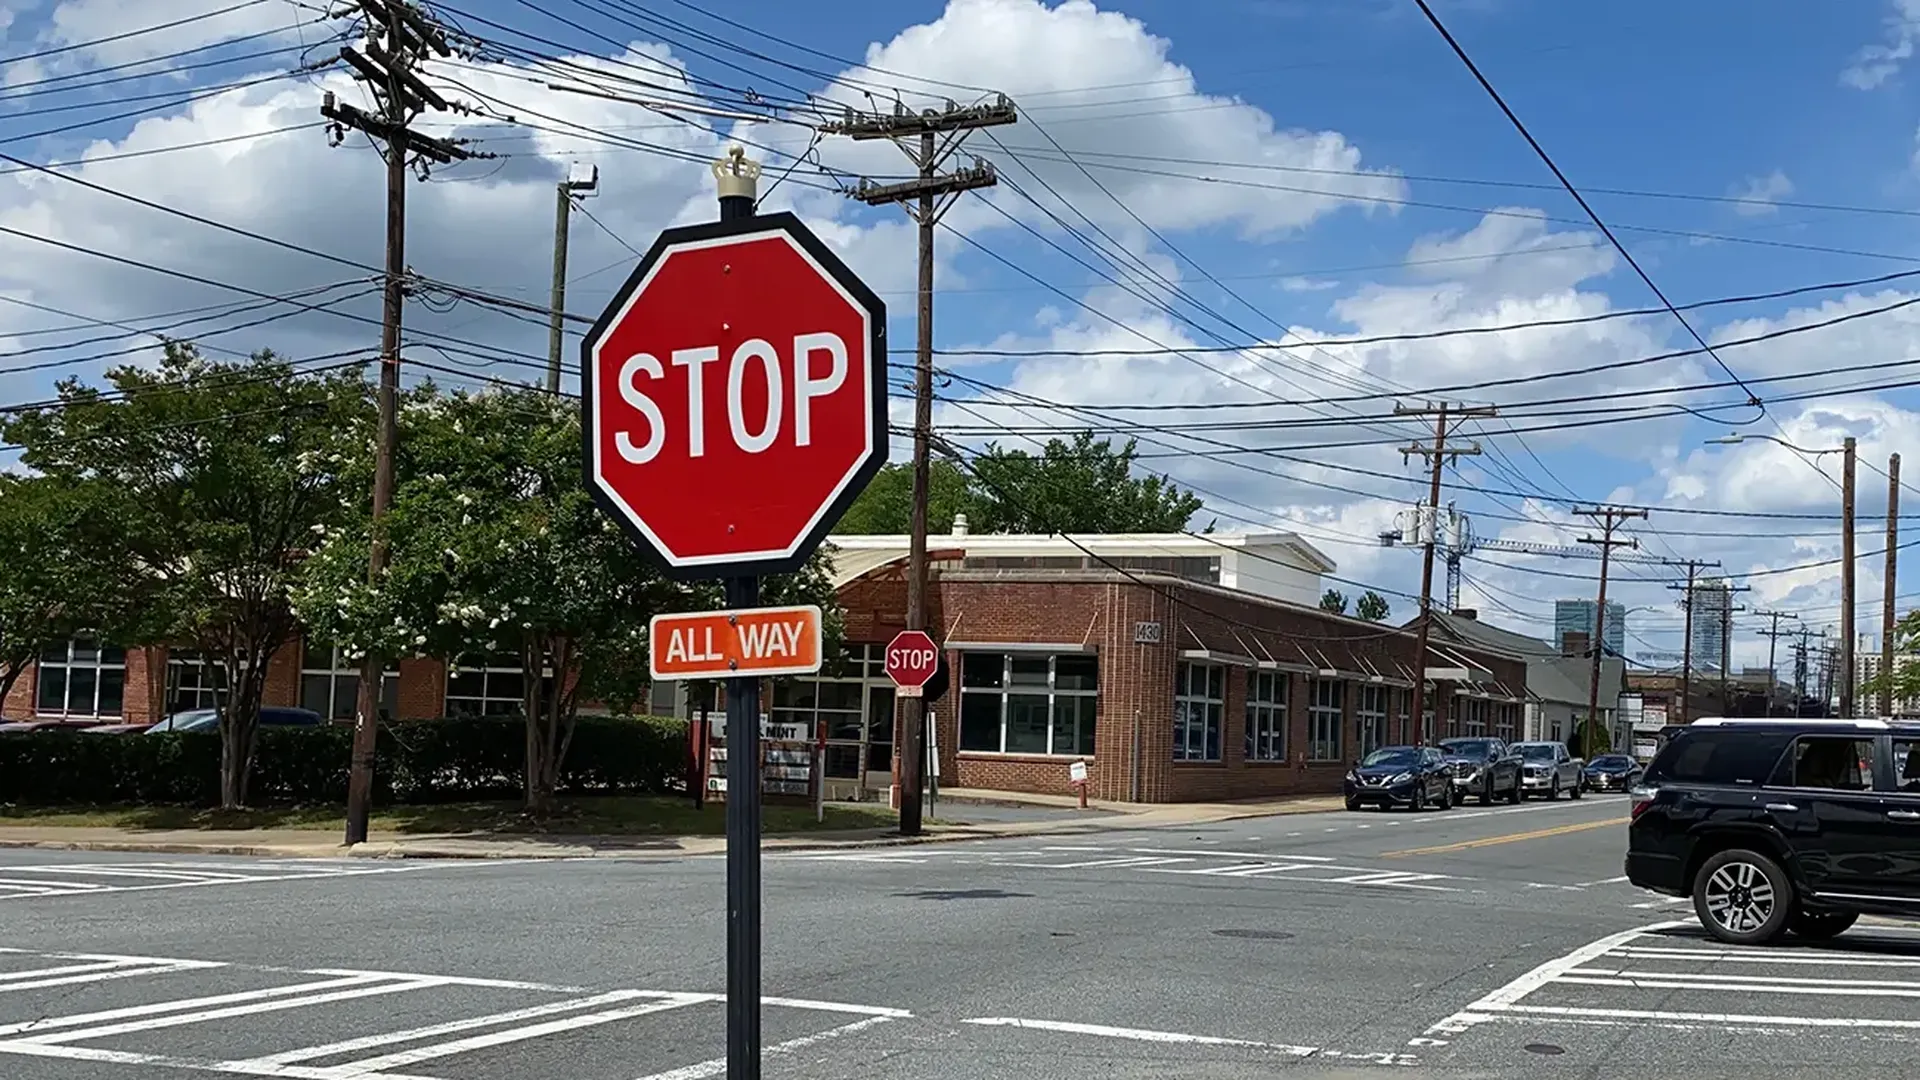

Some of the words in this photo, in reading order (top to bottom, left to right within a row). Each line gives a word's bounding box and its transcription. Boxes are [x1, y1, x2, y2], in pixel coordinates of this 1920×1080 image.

[614, 331, 849, 465] STOP
[665, 626, 724, 664] ALL
[737, 620, 804, 659] WAY
[1136, 624, 1159, 640] 1430
[889, 648, 934, 670] STOP
[766, 726, 797, 739] MINT
